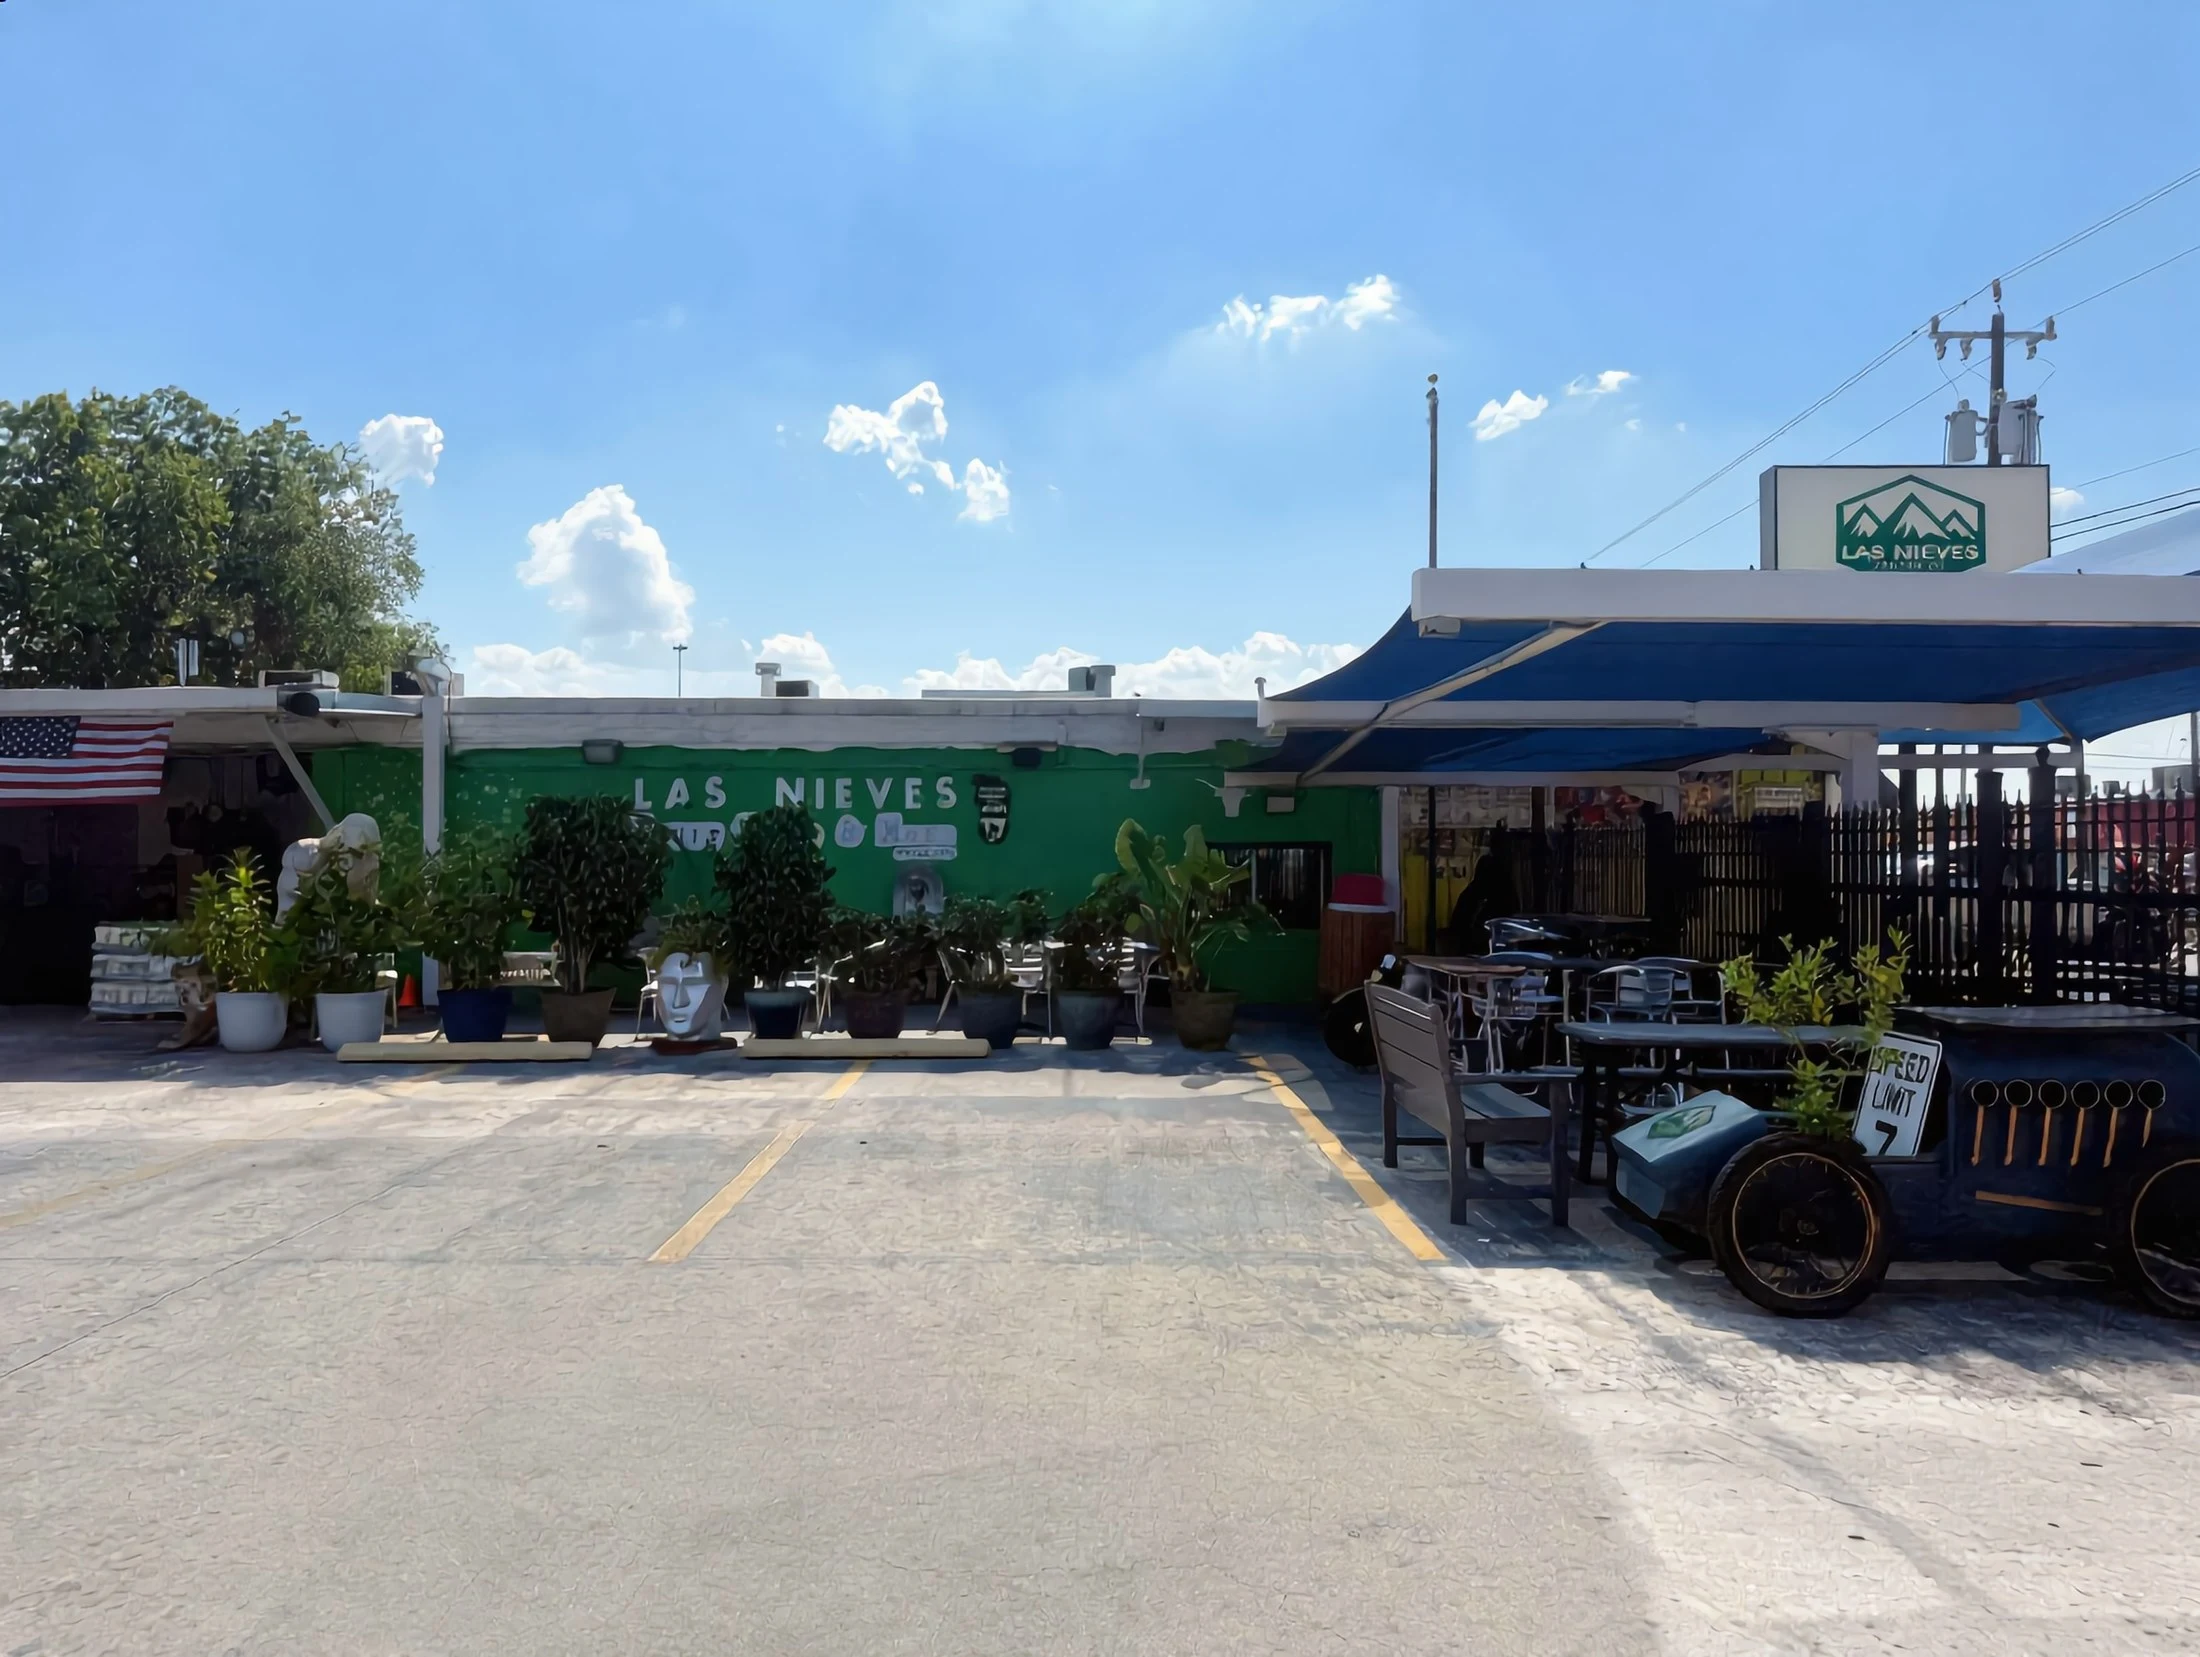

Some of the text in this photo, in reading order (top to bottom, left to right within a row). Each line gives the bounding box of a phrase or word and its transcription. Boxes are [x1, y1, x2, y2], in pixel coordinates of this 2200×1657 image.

[1841, 543, 1979, 561] LAS NIEVES
[634, 776, 958, 811] LAS NIEVES
[1875, 1119, 1898, 1156] 7
